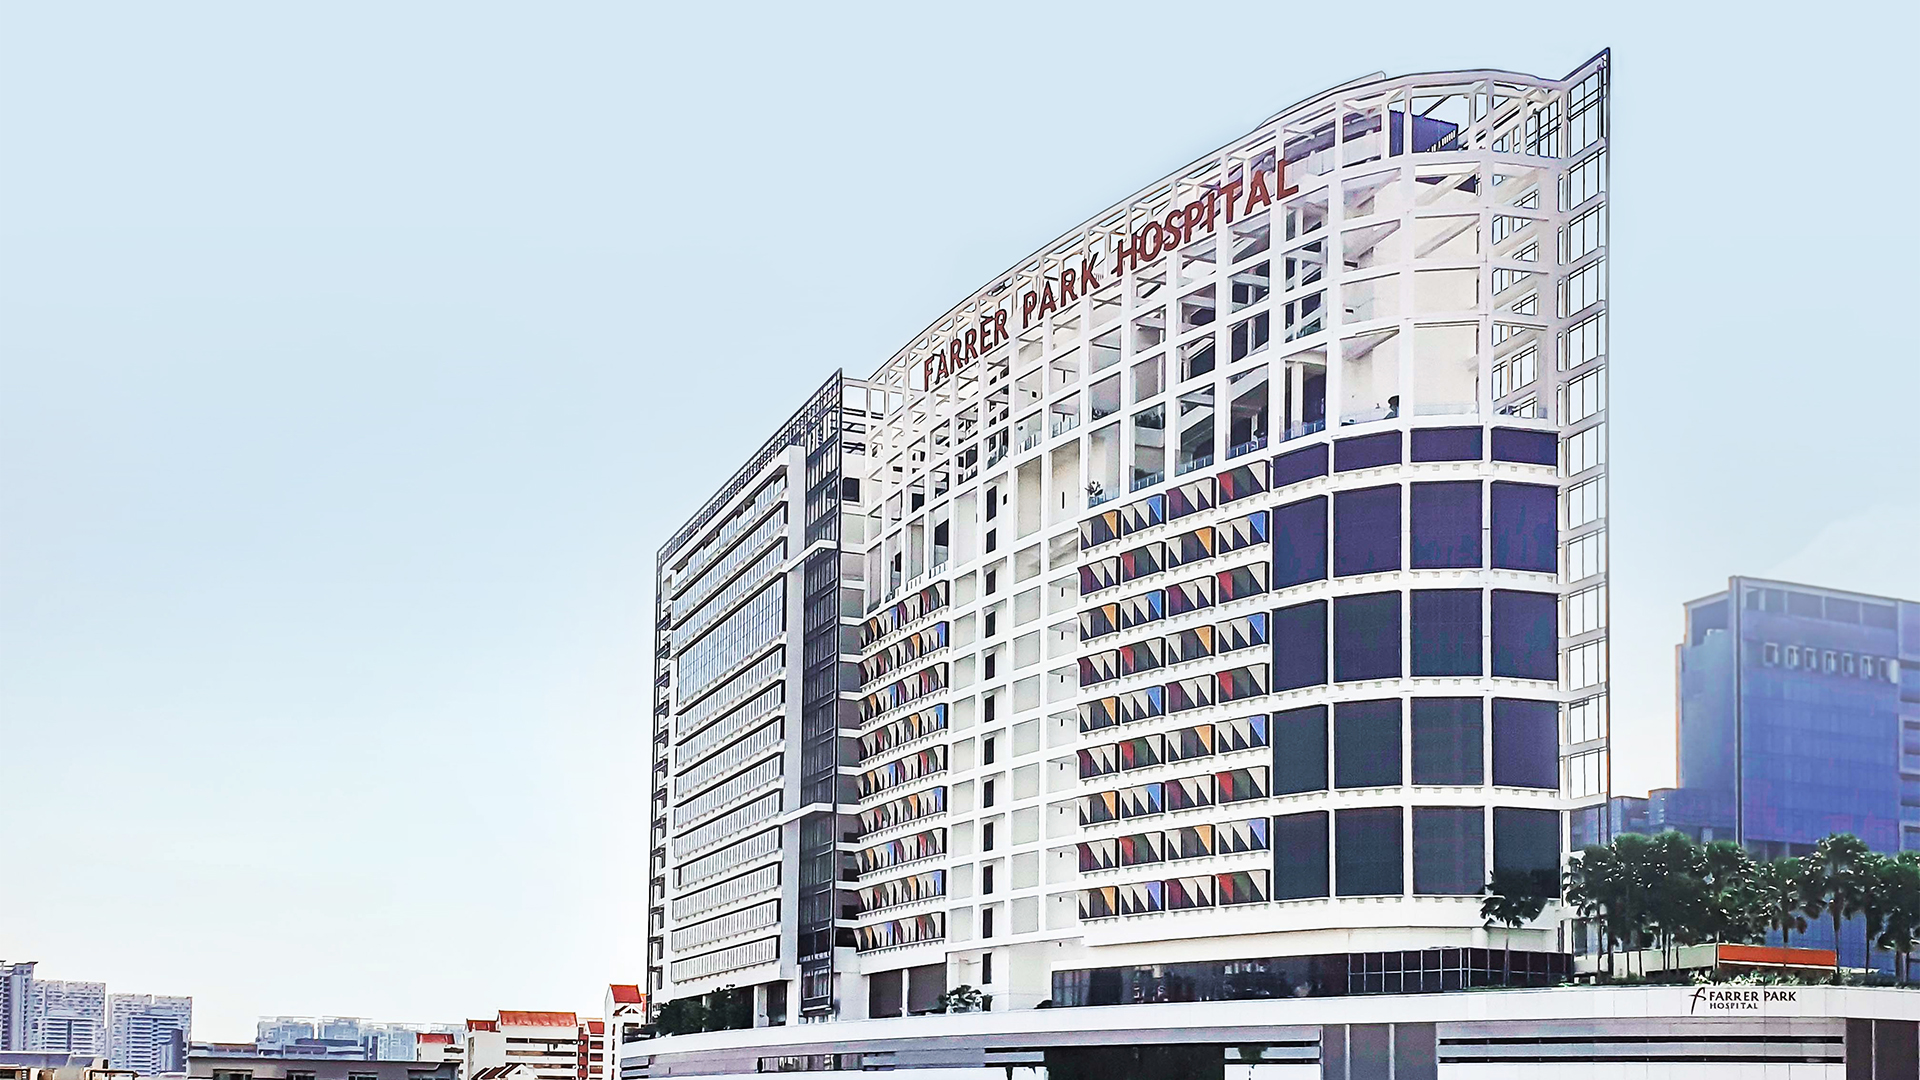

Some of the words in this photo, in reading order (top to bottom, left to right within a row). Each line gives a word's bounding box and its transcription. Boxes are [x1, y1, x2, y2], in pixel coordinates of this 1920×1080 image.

[924, 308, 1009, 393] FARRER
[1022, 252, 1100, 329] PARK
[1115, 158, 1299, 277] HOSPITAL
[1709, 991, 1759, 1001] FARRER
[1764, 991, 1796, 1001] PARK
